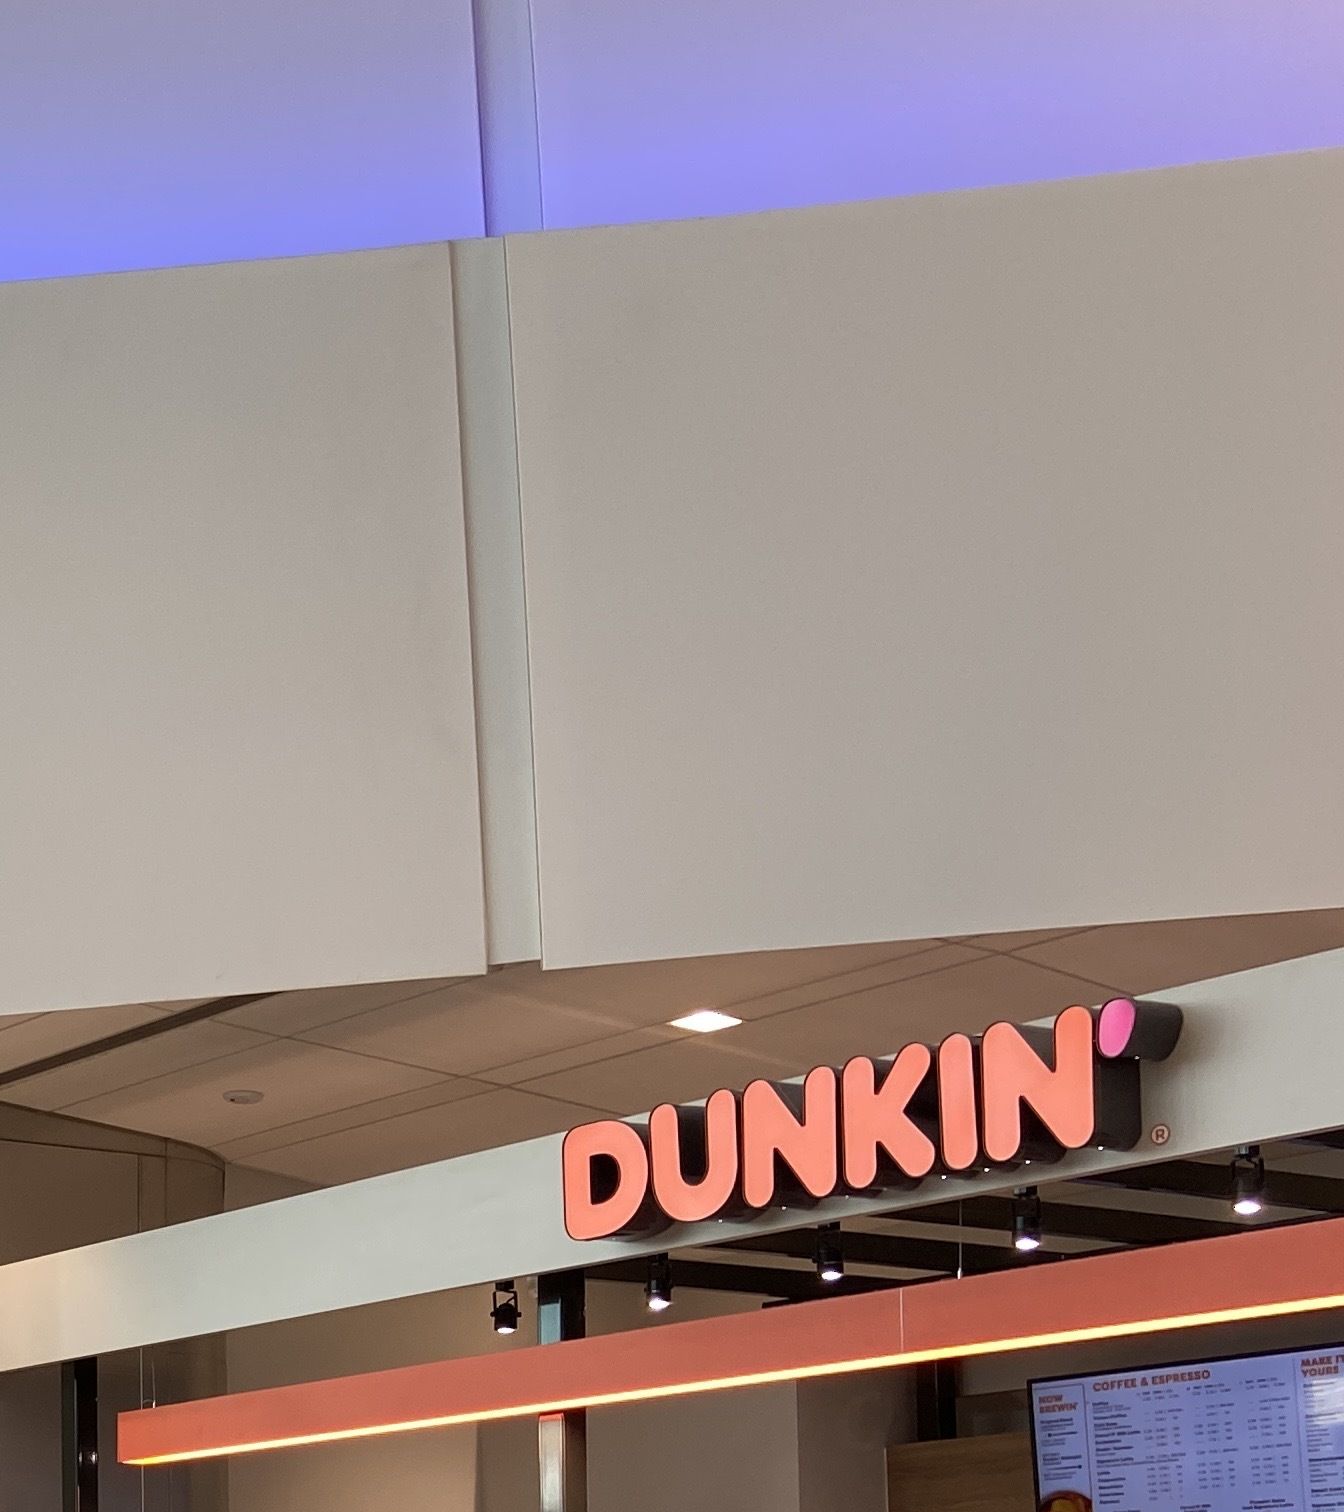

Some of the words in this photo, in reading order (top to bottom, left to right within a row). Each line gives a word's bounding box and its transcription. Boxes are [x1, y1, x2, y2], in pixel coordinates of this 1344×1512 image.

[562, 997, 1142, 1242] DUNKIN'
[1092, 1377, 1137, 1393] COFFEE
[1151, 1370, 1211, 1386] ESPRESSO
